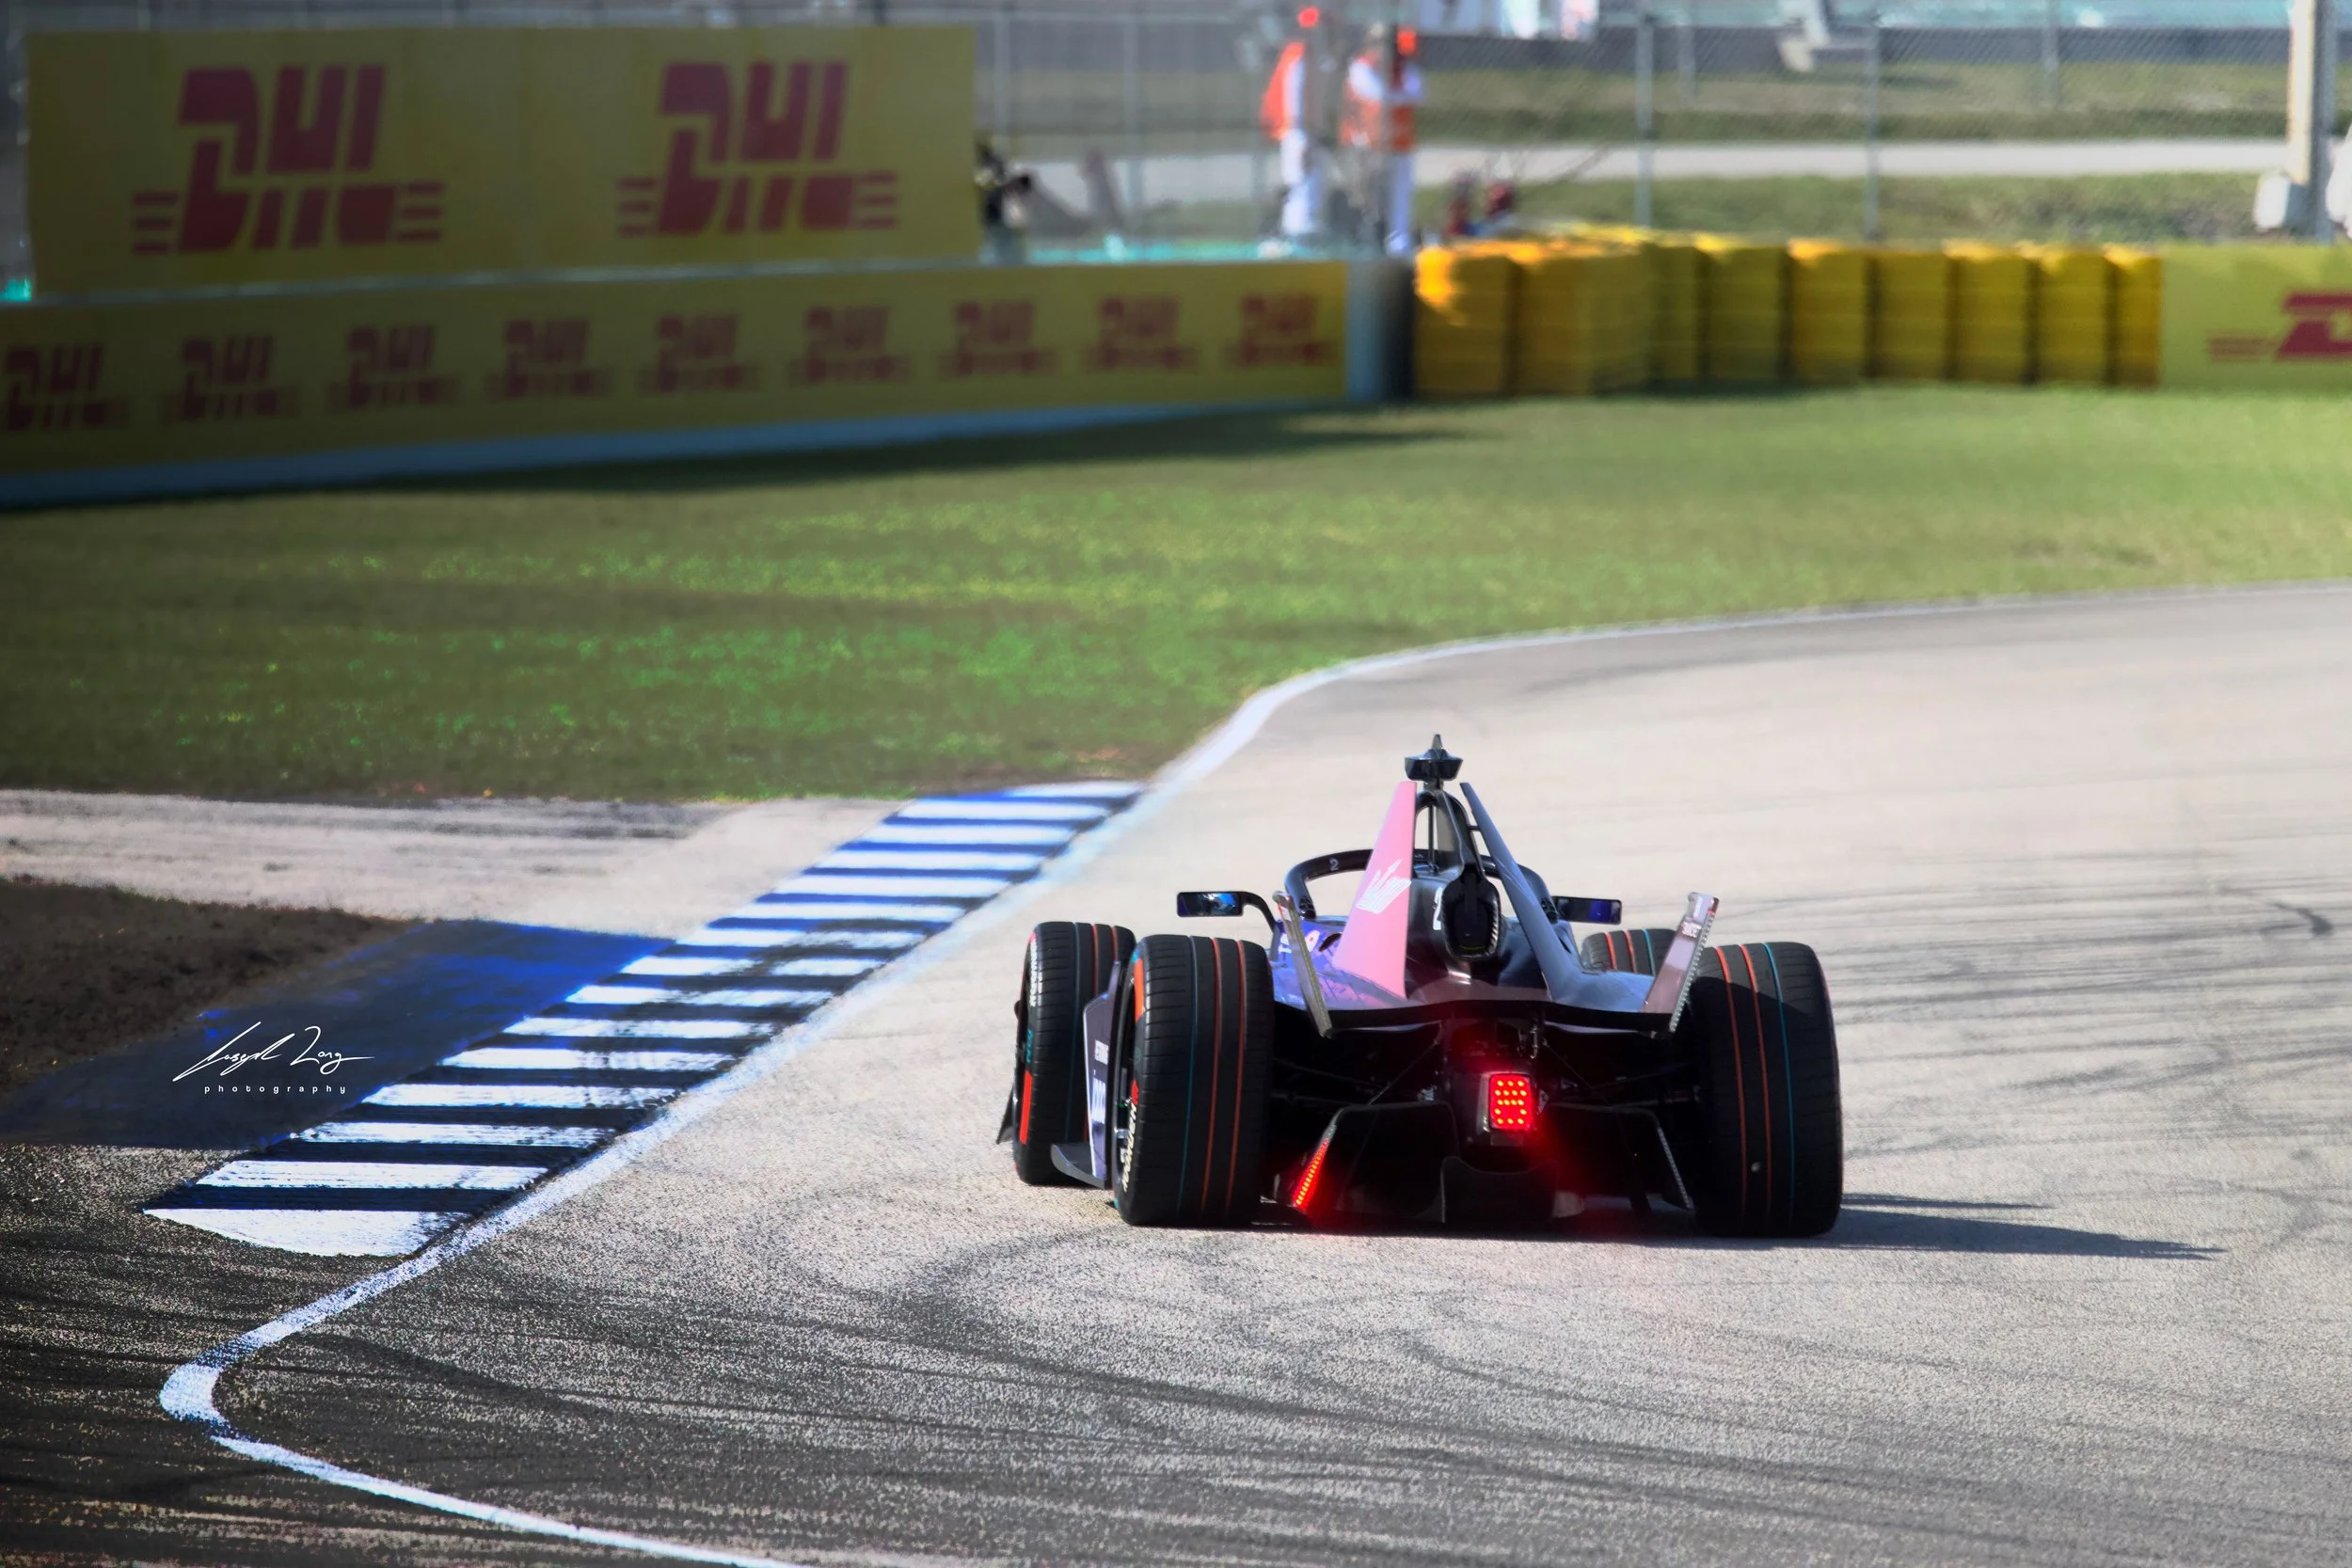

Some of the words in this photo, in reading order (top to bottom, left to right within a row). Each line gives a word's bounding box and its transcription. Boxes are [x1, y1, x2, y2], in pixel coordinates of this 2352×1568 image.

[177, 64, 399, 255] DHL
[657, 61, 853, 236] DHL
[1329, 858, 1339, 871] 2
